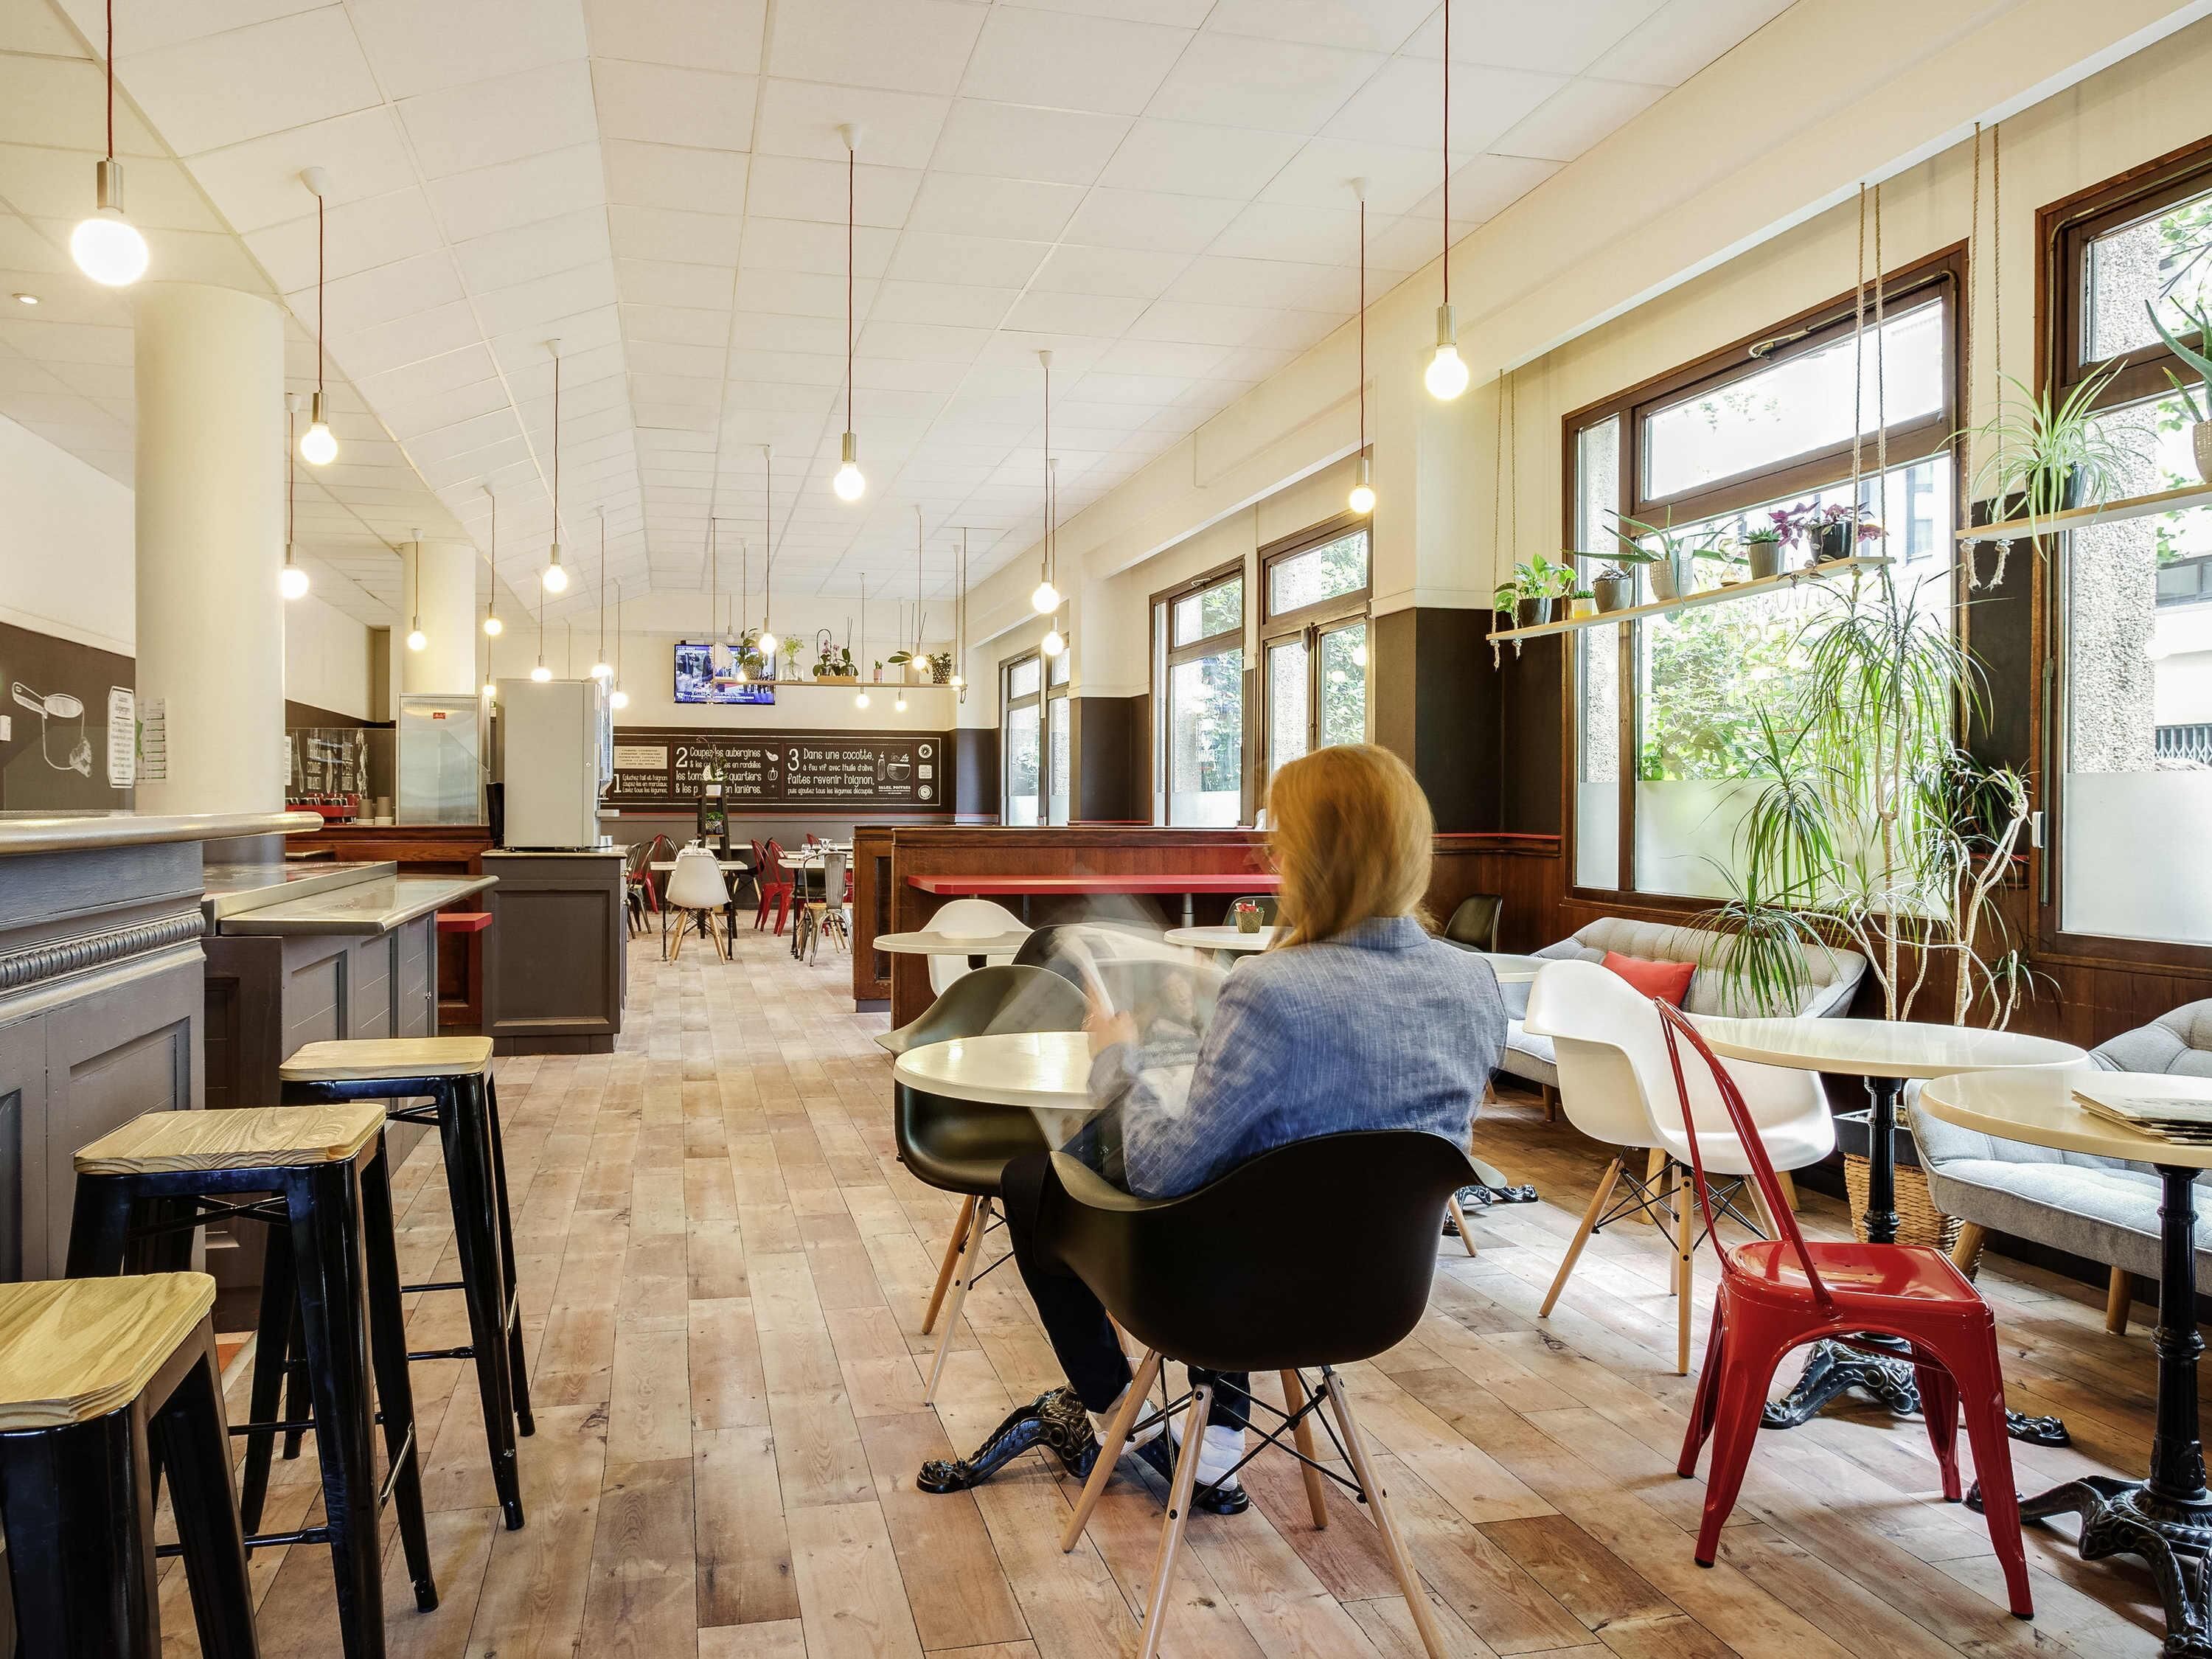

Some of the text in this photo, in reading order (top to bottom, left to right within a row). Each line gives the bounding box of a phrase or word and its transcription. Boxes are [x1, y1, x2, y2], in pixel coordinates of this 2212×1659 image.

[675, 747, 688, 768] 2
[726, 747, 761, 760] aubergines
[787, 748, 799, 771] 3
[803, 748, 874, 761] Dans une cocotte,
[808, 763, 818, 771] feu
[613, 773, 622, 793] 1
[676, 771, 686, 781] les
[728, 771, 762, 784] quartiers
[787, 773, 811, 785] faites
[813, 774, 842, 785] revenir
[675, 783, 680, 793] &
[682, 782, 692, 793] les
